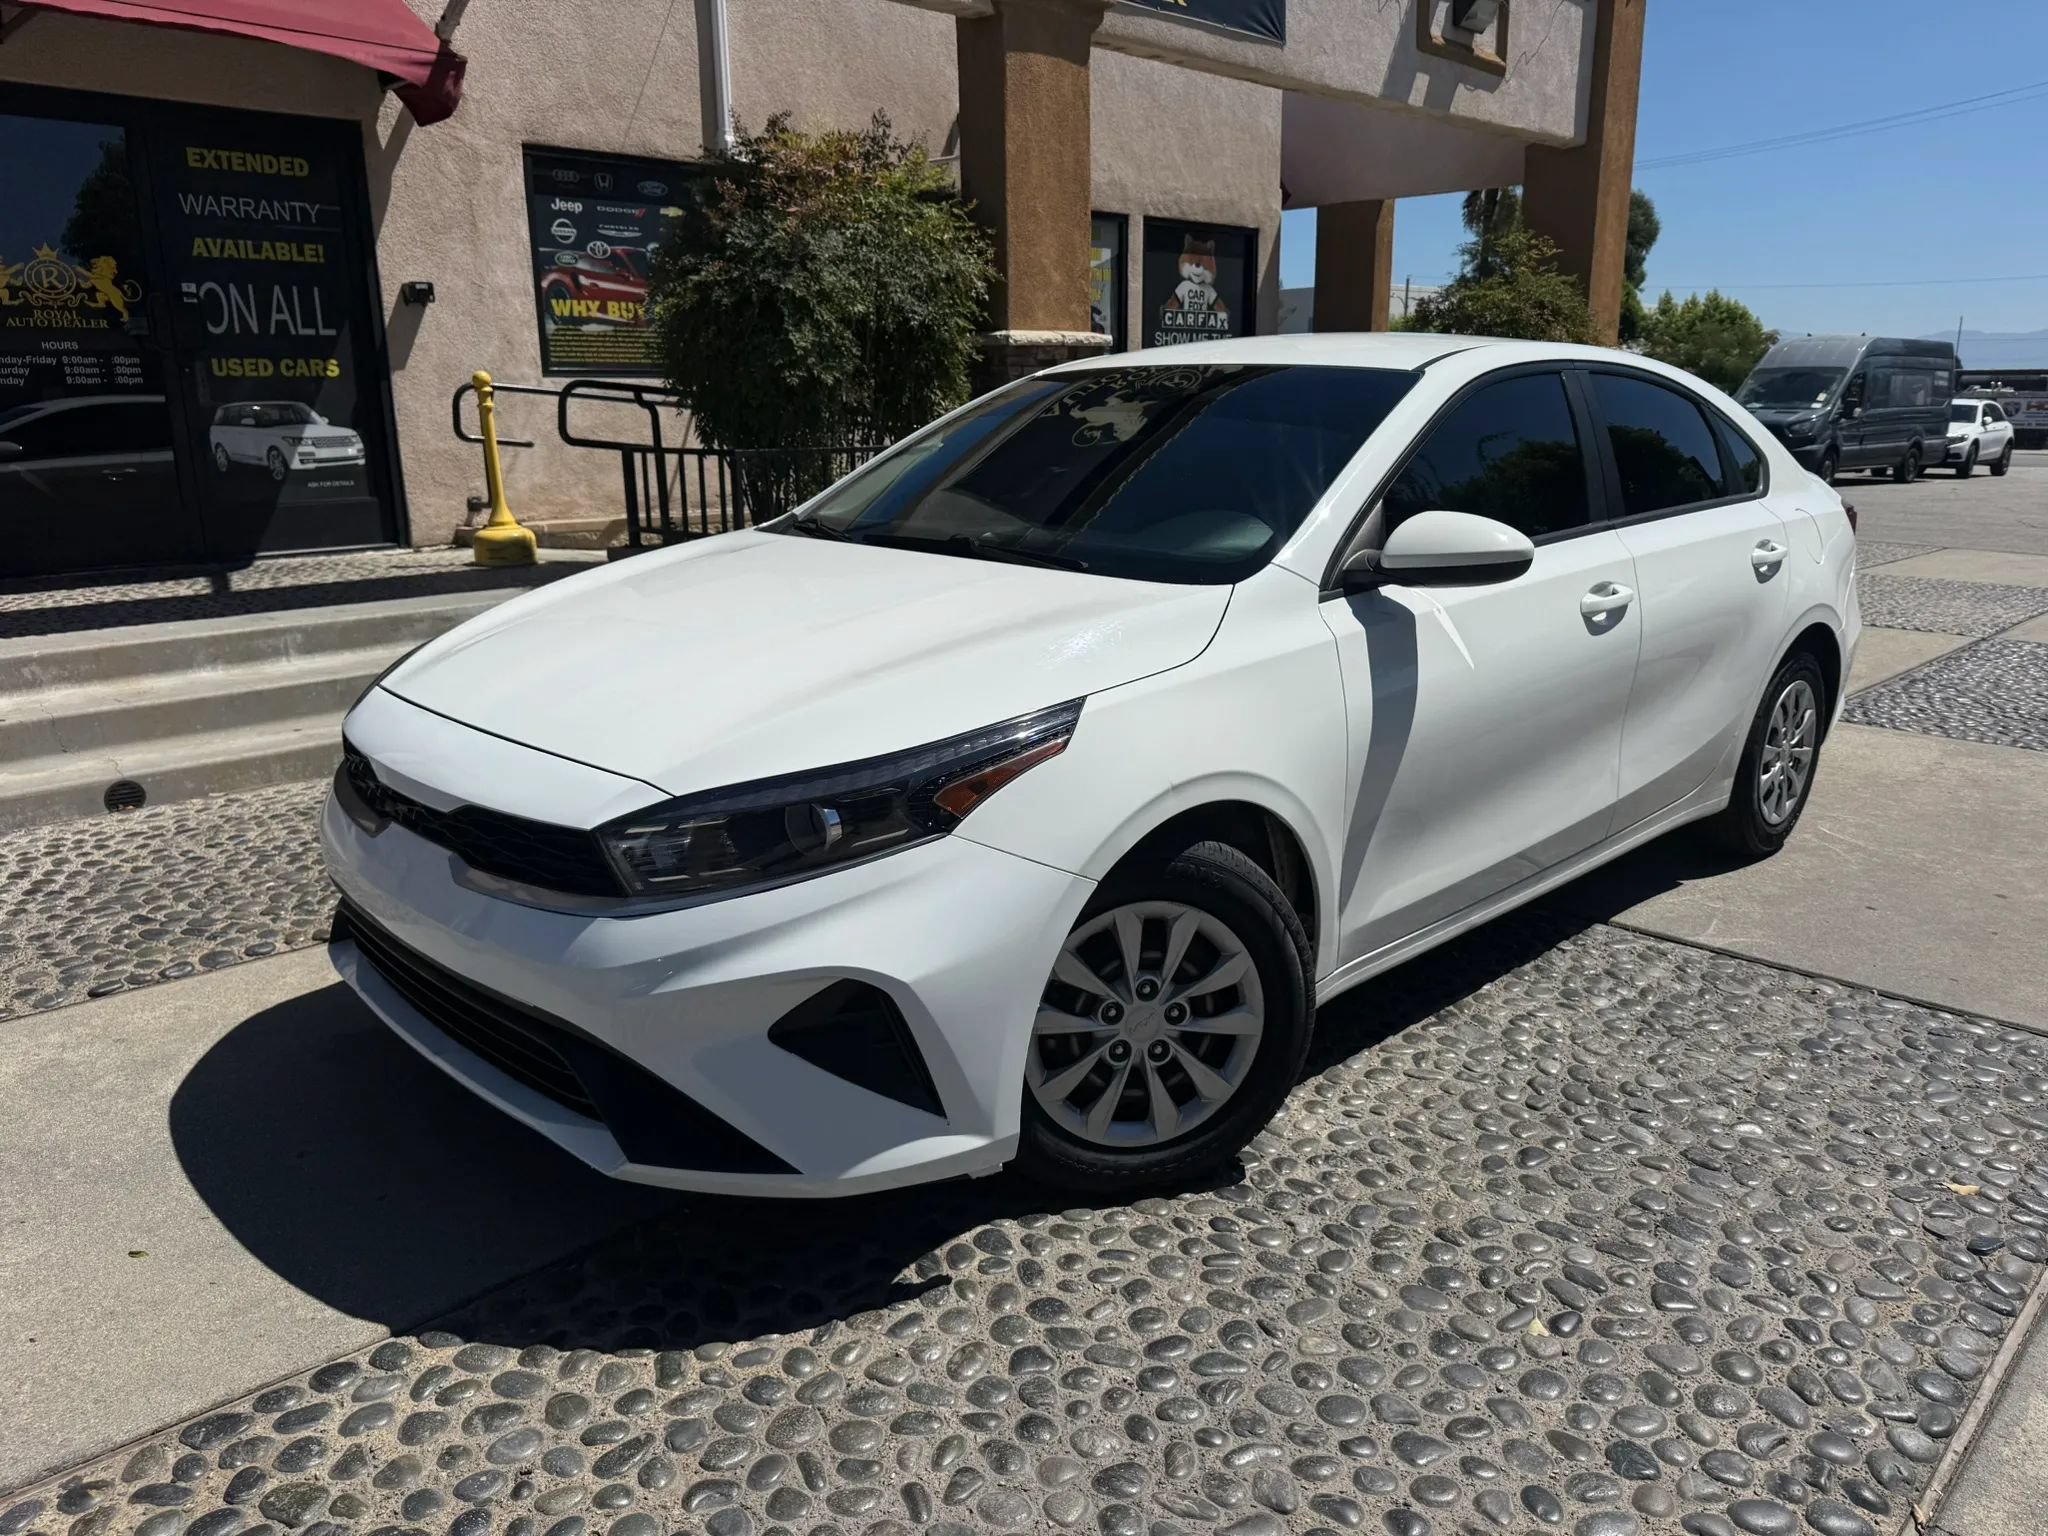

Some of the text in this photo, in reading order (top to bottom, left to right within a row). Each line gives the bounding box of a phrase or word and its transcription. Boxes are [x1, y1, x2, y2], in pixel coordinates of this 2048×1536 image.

[184, 146, 311, 177] EXTENDED
[177, 192, 320, 224] WARRANTY
[550, 197, 583, 214] Jeep
[191, 236, 326, 264] AVAILABLE!
[1187, 289, 1205, 301] CAR
[33, 309, 81, 320] ROYAL
[269, 284, 337, 336] ALL
[550, 298, 601, 318] WHY
[6, 316, 110, 329] AUTO DEALER
[1164, 312, 1227, 328] CARFAX
[41, 341, 79, 350] HOURS
[1154, 331, 1191, 346] SHOW
[0, 355, 57, 366] nday-Friday
[211, 357, 341, 379] USED CARS
[0, 376, 25, 387] nday
